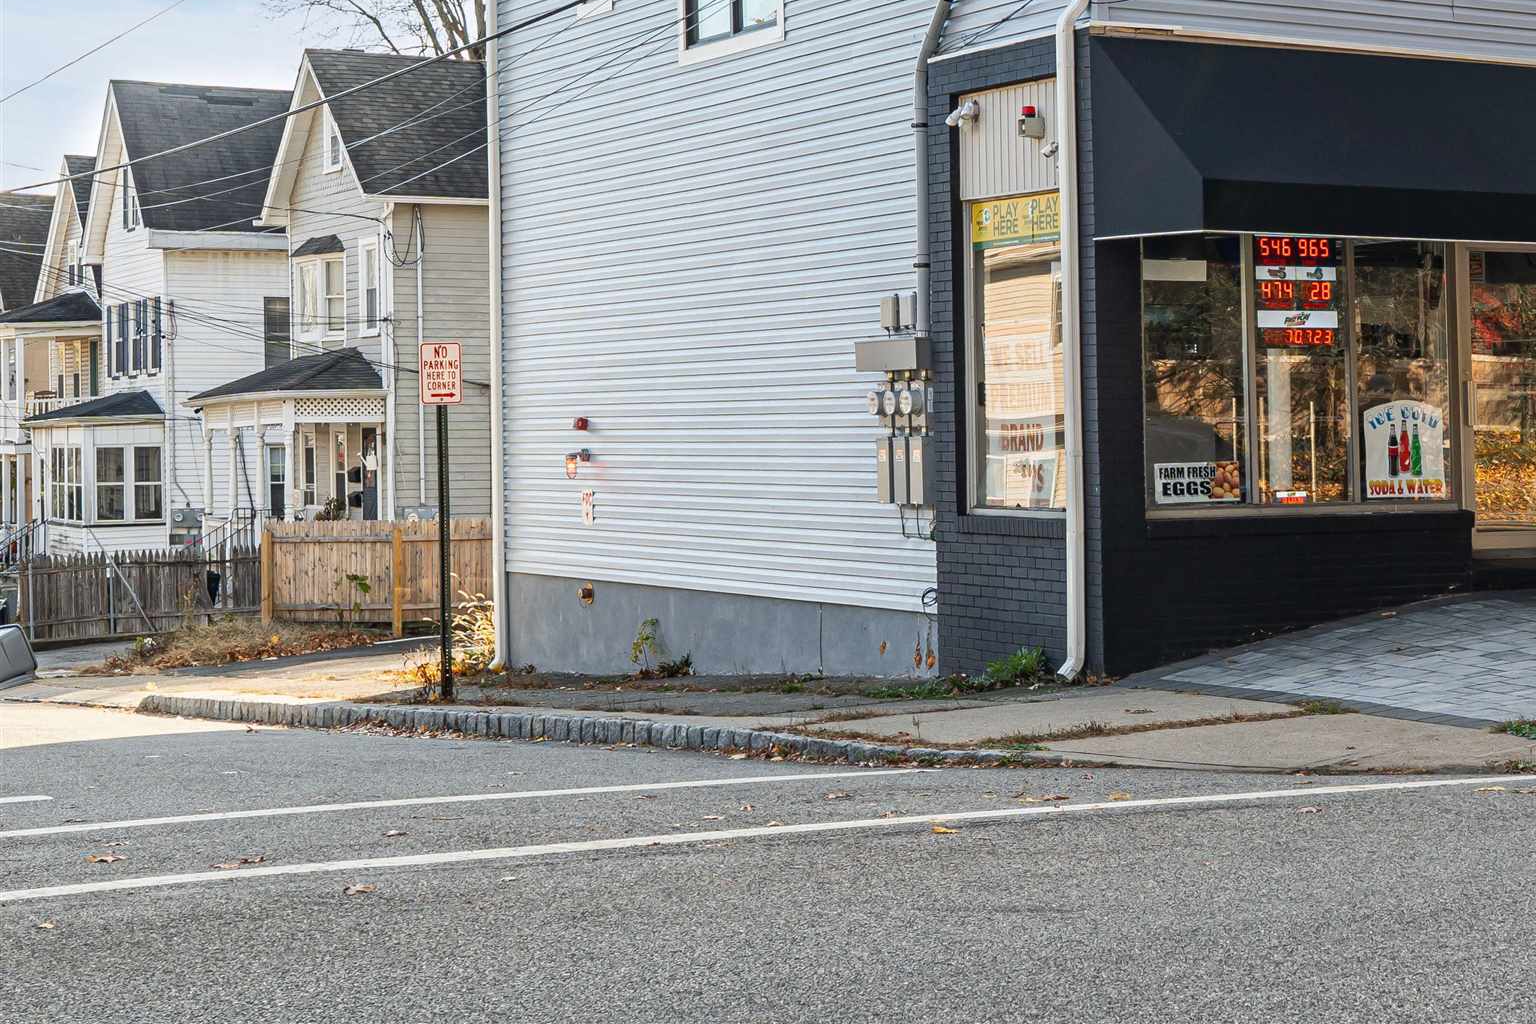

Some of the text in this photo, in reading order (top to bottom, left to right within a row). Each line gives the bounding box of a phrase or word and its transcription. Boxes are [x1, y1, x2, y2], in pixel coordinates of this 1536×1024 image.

[993, 202, 1018, 219] PLAY
[1032, 196, 1059, 214] PLAY
[993, 218, 1019, 236] HERE
[1032, 213, 1059, 231] HERE
[1260, 238, 1329, 257] 546 965
[1261, 282, 1331, 300] 474 28
[434, 345, 448, 358] NO
[424, 360, 458, 370] PARKING
[427, 370, 456, 379] HERE TO
[427, 381, 456, 390] CORNER
[1001, 423, 1044, 452] BRAND
[1159, 465, 1216, 479] FARM FRESH
[1162, 481, 1212, 496] EGGS
[1369, 480, 1396, 495] SODA
[1406, 479, 1443, 495] WATER
